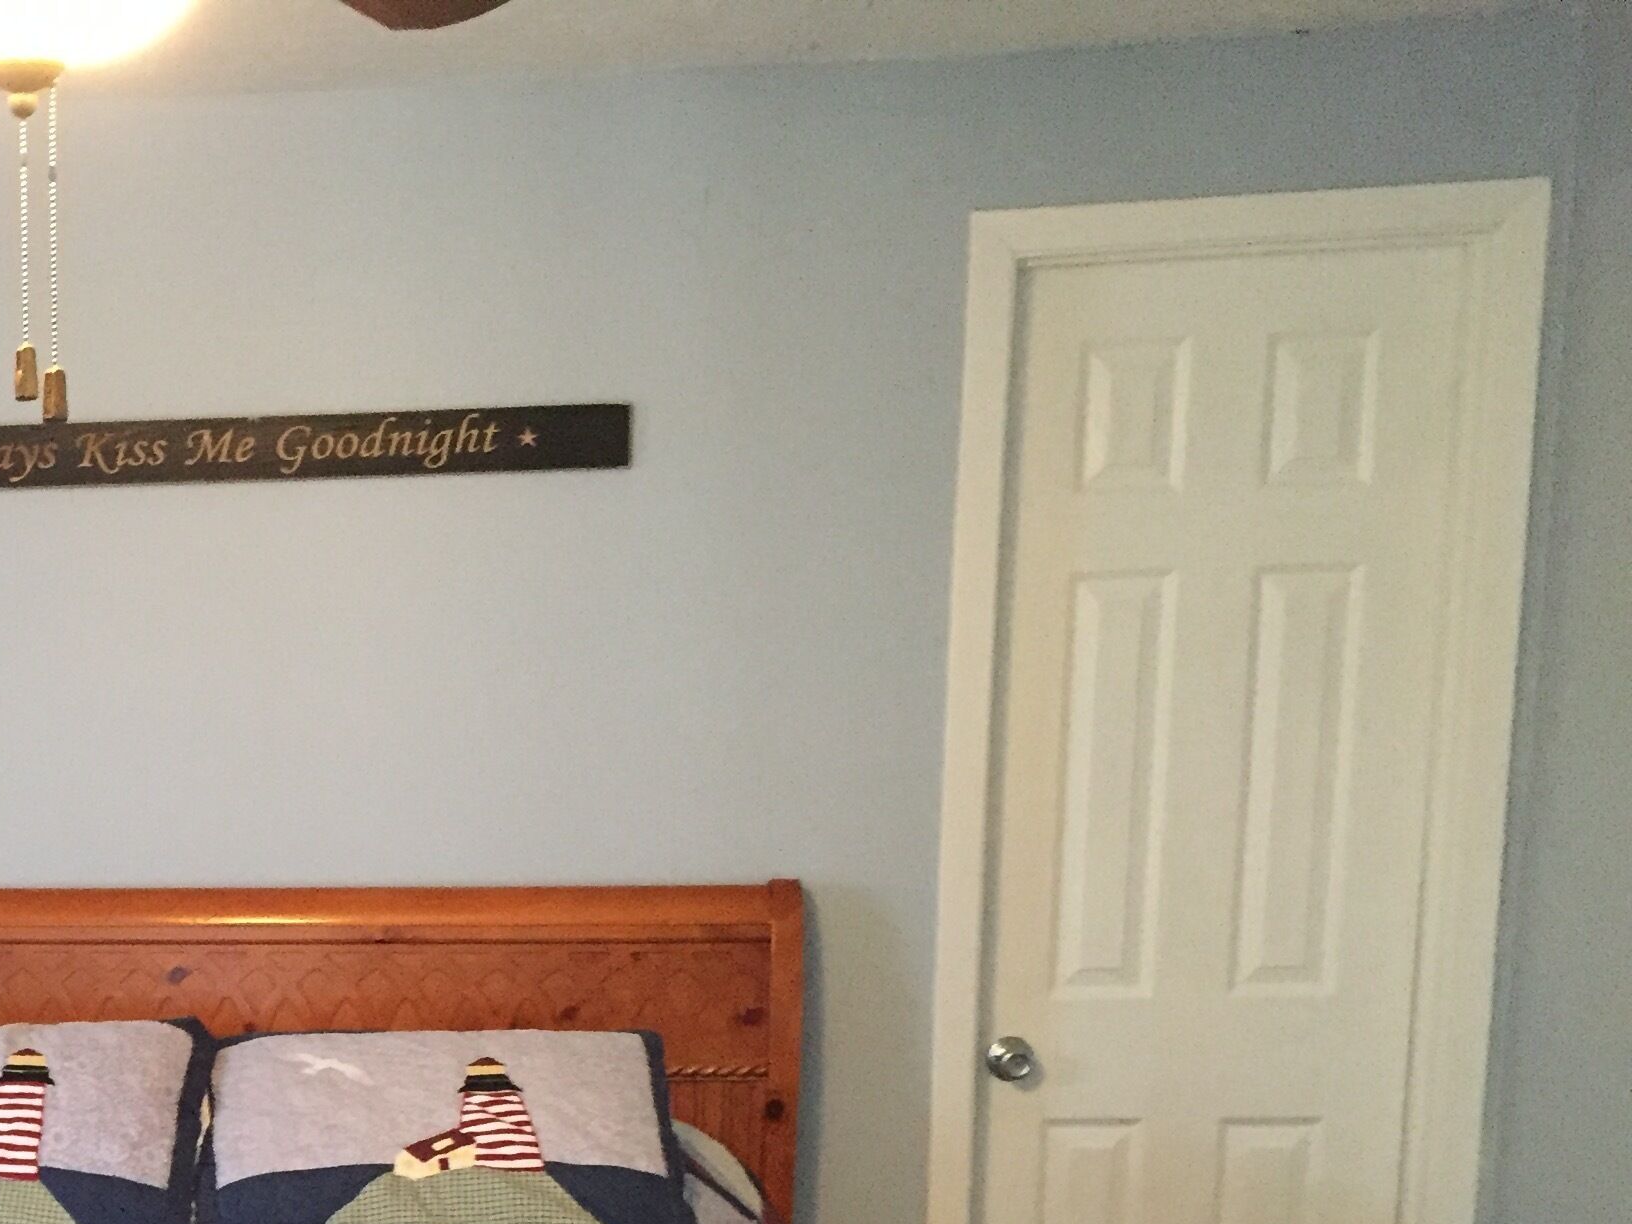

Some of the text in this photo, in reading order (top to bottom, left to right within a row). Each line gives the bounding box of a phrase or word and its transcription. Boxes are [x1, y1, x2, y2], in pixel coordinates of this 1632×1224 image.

[75, 431, 168, 475] Kiss
[184, 427, 257, 466] Me
[275, 413, 502, 475] Goodnight
